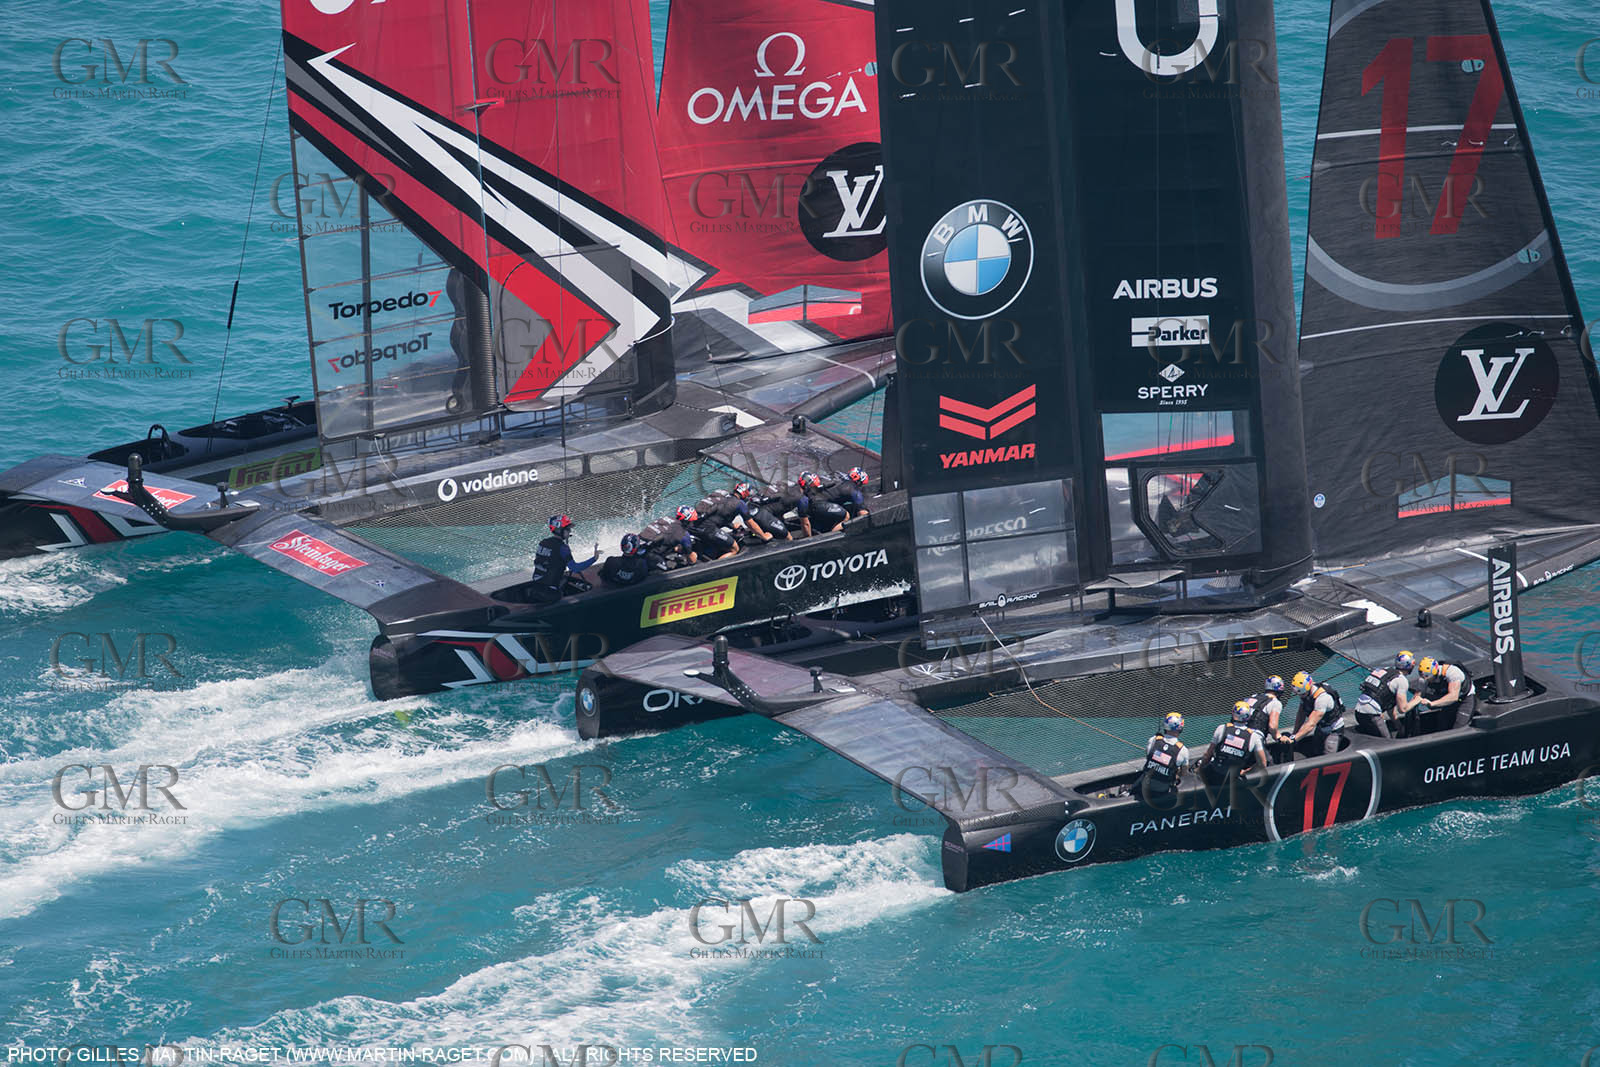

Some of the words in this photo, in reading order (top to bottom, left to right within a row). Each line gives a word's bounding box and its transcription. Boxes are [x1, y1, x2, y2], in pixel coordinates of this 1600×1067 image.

[687, 76, 867, 125] OMEGA
[1361, 34, 1504, 239] 17
[933, 204, 1024, 245] BMW
[328, 289, 442, 320] Torpedo7
[1112, 277, 1218, 299] AIRBUS
[1148, 325, 1208, 342] Parker
[1138, 384, 1208, 399] SPERRY
[1457, 348, 1535, 421] LV
[940, 443, 1035, 469] YANMAR
[462, 469, 538, 493] vodafone
[810, 549, 889, 582] TOYOTA
[648, 584, 729, 620] PIRELLI
[1492, 558, 1515, 655] AIRBUS
[1423, 758, 1485, 784] ORACLE
[1490, 749, 1535, 771] TEAM
[1539, 742, 1571, 762] USA
[1300, 761, 1353, 833] 17
[1129, 805, 1233, 835] PANERAI
